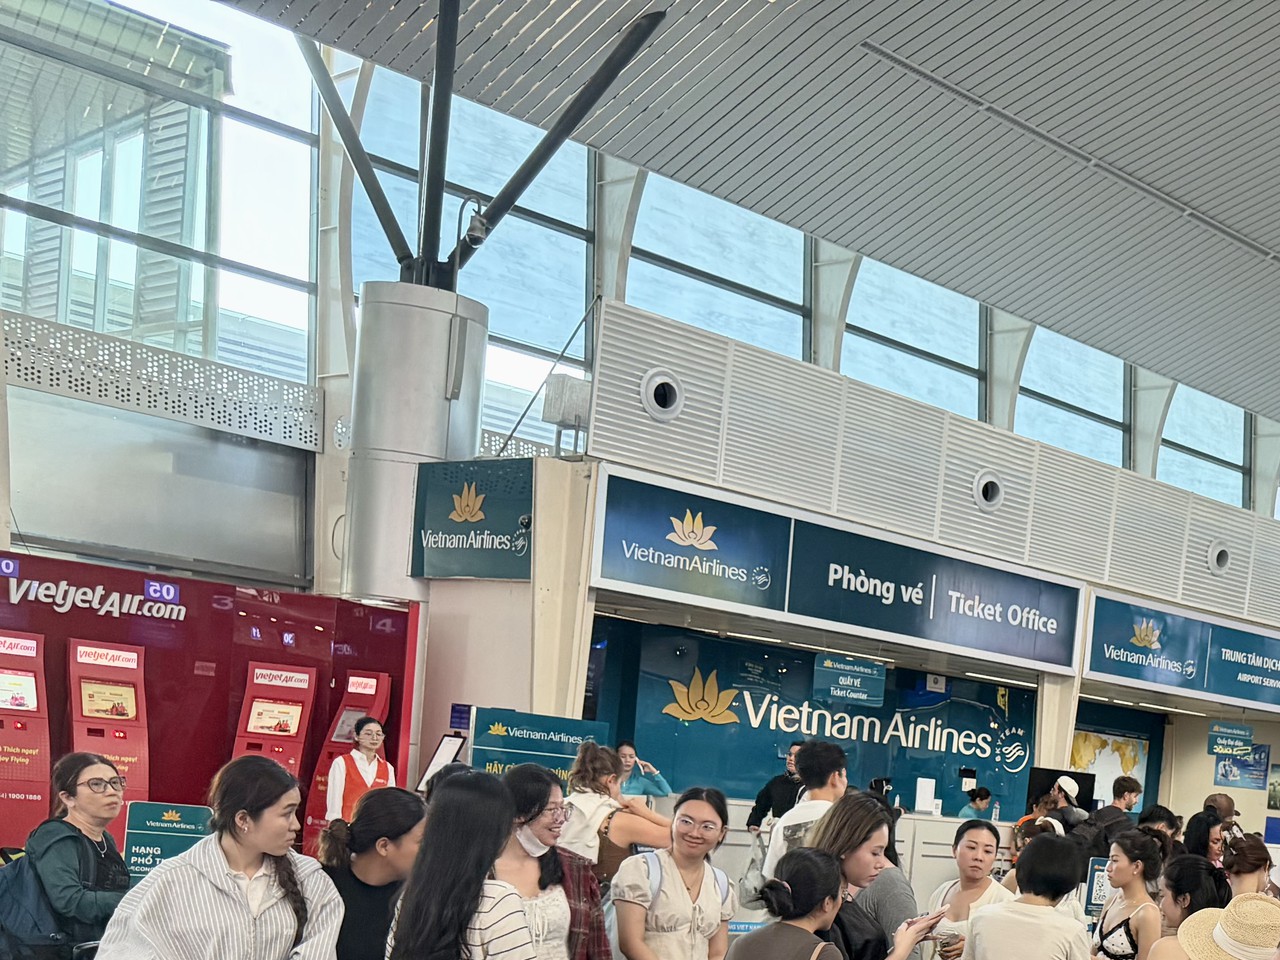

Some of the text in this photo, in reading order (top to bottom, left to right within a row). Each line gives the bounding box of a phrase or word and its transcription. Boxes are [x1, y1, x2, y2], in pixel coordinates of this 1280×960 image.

[828, 563, 924, 606] Phòng vé
[949, 591, 1058, 635] Ticket Office
[1221, 648, 1247, 665] TRUNG
[1247, 653, 1262, 667] TÂM
[1237, 672, 1263, 684] AIRPORT
[830, 687, 868, 700] Ticket Counter
[132, 845, 161, 855] HẠNG
